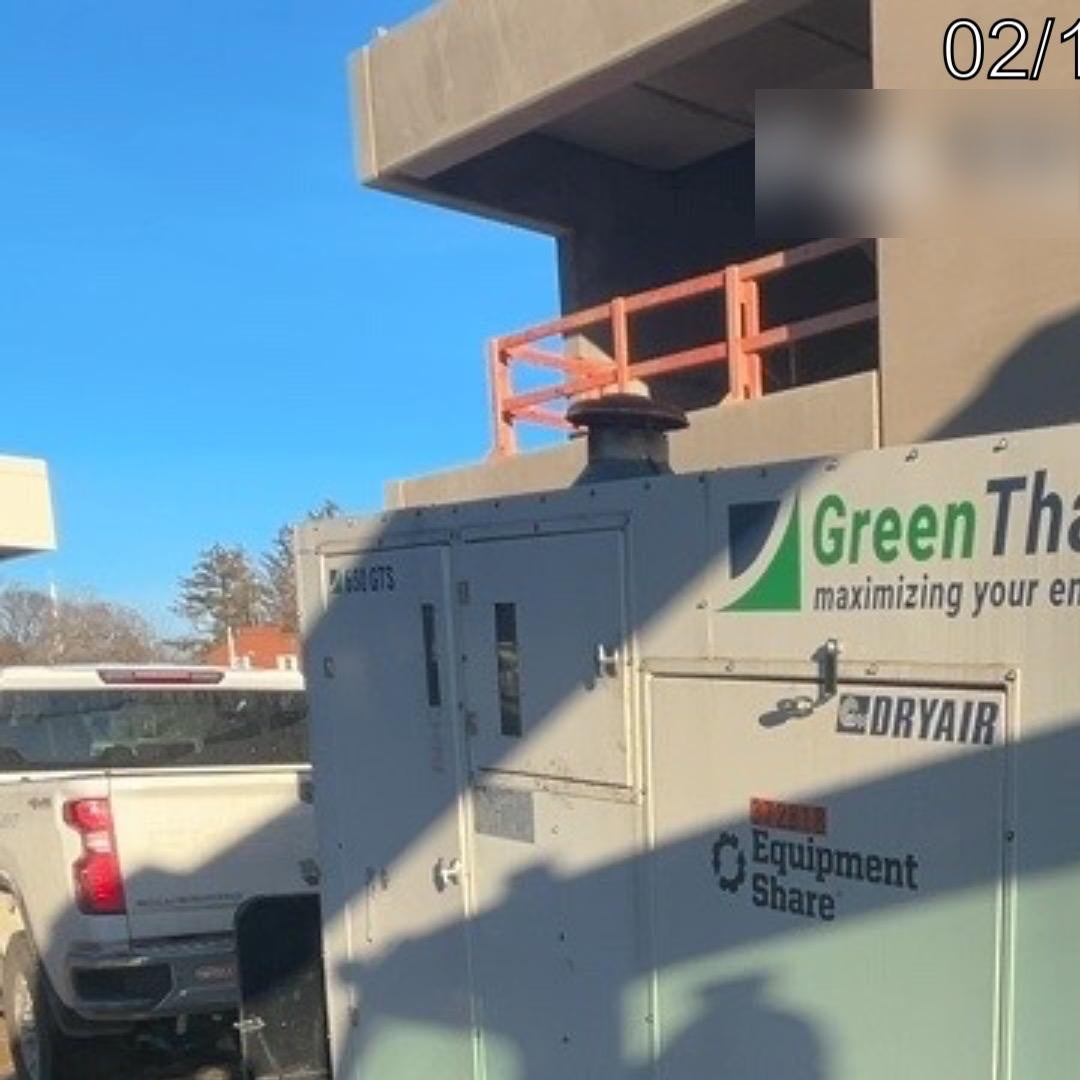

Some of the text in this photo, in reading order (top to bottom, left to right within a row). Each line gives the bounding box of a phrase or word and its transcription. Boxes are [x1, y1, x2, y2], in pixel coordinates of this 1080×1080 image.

[813, 573, 964, 618] maximizing
[971, 578, 1040, 618] your
[870, 695, 999, 745] DRYAIR
[752, 829, 918, 890] Equipment
[751, 872, 836, 921] Share
